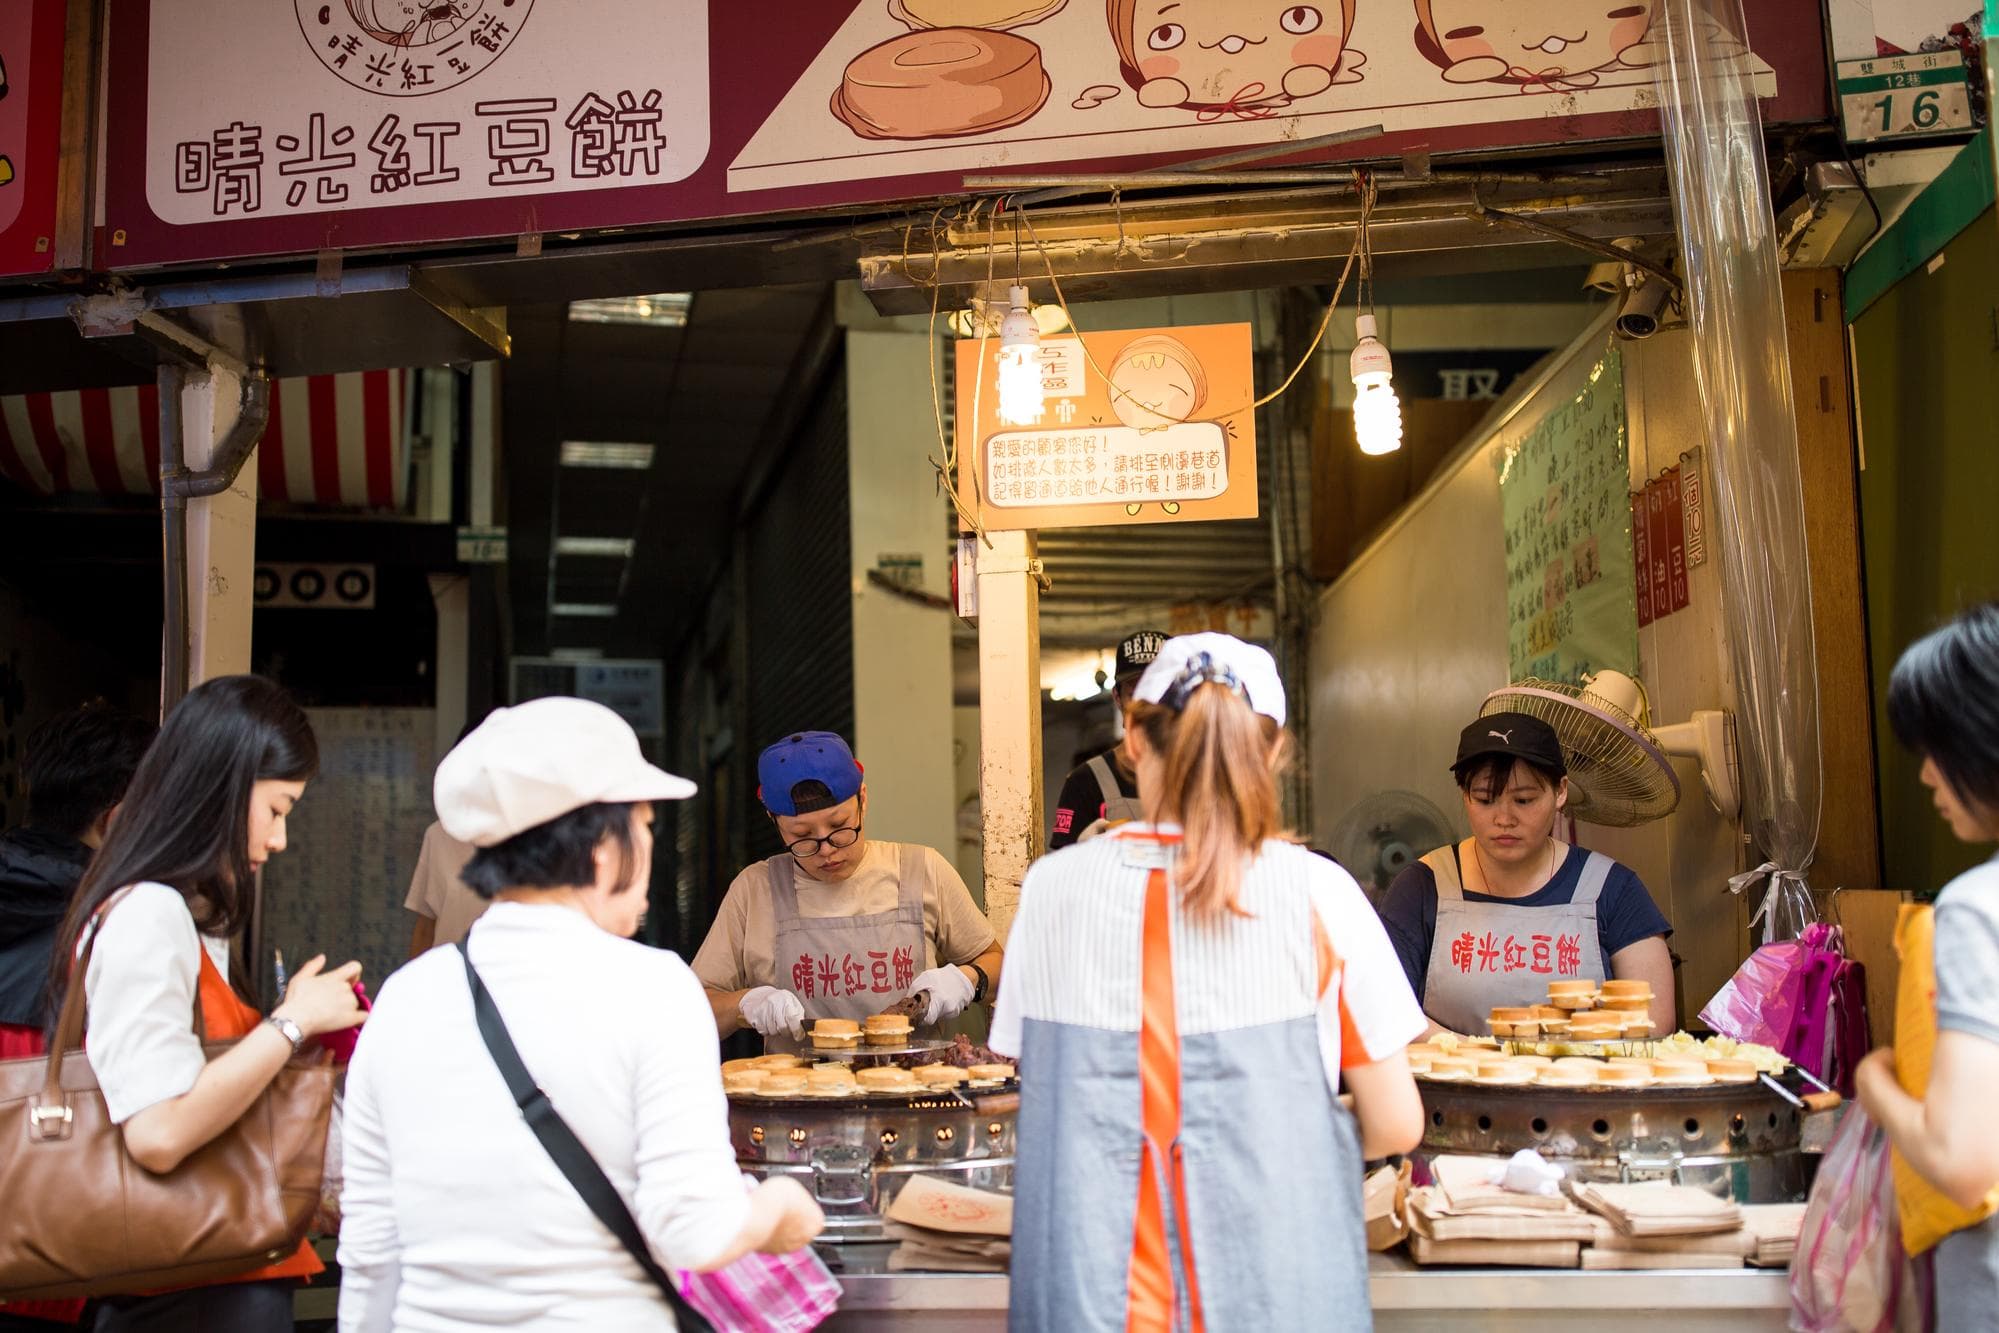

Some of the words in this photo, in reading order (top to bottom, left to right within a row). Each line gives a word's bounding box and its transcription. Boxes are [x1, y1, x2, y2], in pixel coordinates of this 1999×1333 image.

[328, 13, 510, 90] 晴光紅豆餅
[1860, 55, 1938, 76] 雙城街
[1885, 72, 1922, 89] 12巷
[1874, 90, 1940, 132] 16
[175, 88, 667, 215] 晴光紅豆餅
[792, 944, 915, 1000] 晴光紅豆餅
[1451, 931, 1581, 977] 晴光紅豆餅
